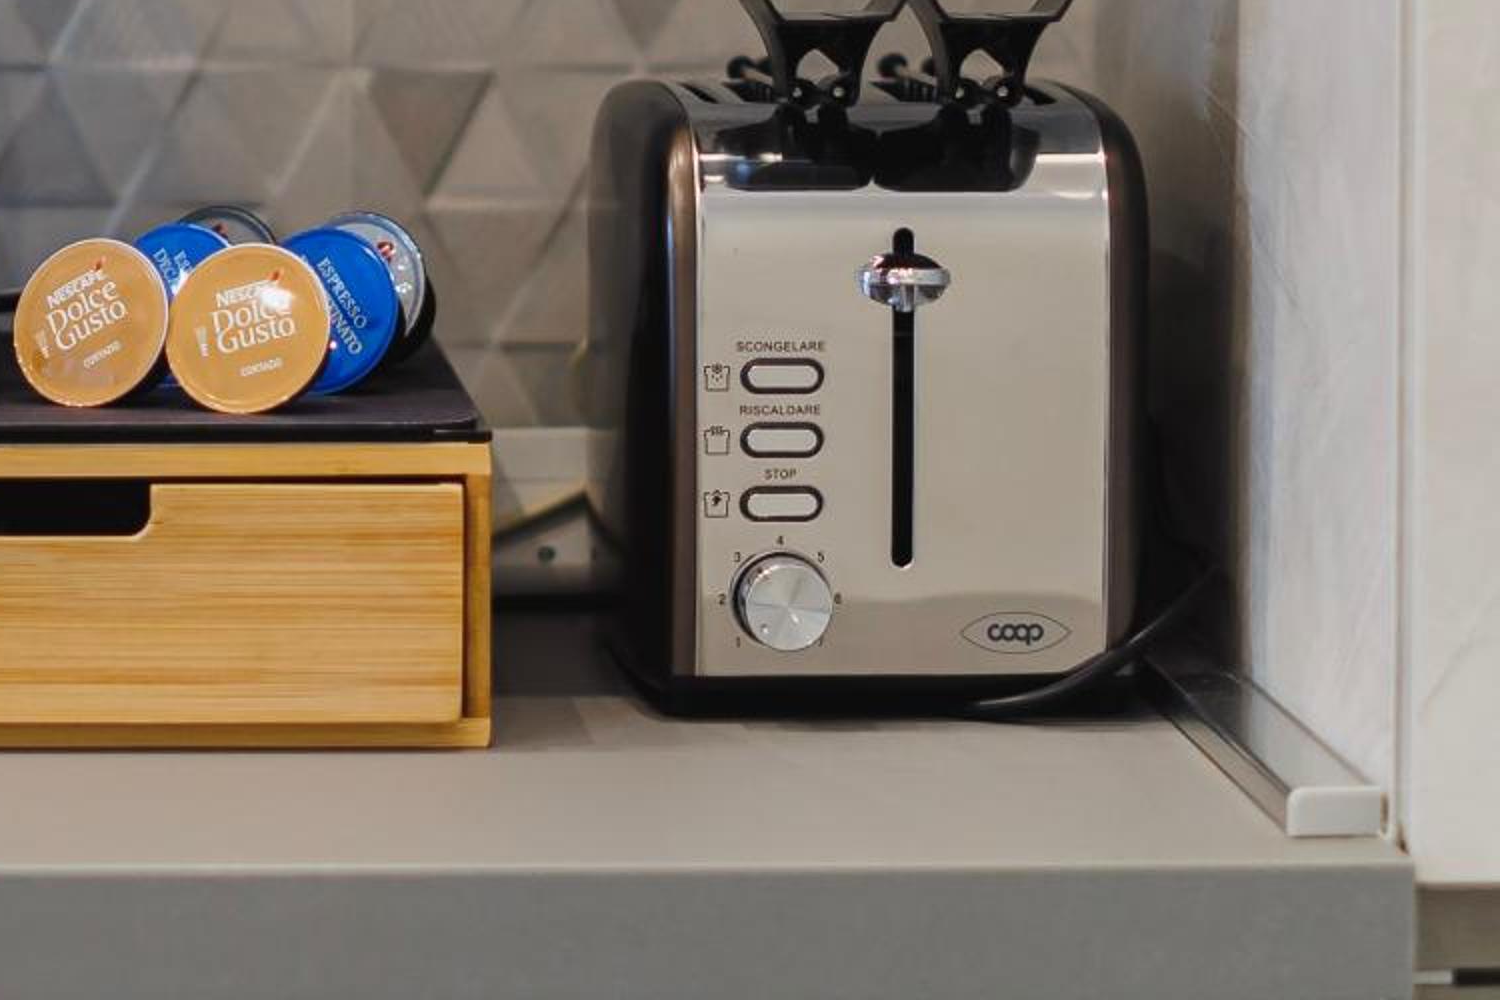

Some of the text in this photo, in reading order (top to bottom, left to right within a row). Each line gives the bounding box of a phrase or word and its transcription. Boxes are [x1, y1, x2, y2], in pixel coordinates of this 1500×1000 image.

[316, 256, 367, 329] ESPRESSO
[46, 281, 118, 334] Dolce
[55, 300, 127, 351] Gusto
[216, 316, 296, 354] Gusto
[736, 341, 825, 353] SCONGELARE
[763, 468, 797, 480] STOP
[775, 535, 784, 546] 4
[733, 551, 741, 563] 3
[817, 551, 825, 563] 5
[718, 593, 727, 605] 2
[987, 623, 1045, 646] coop
